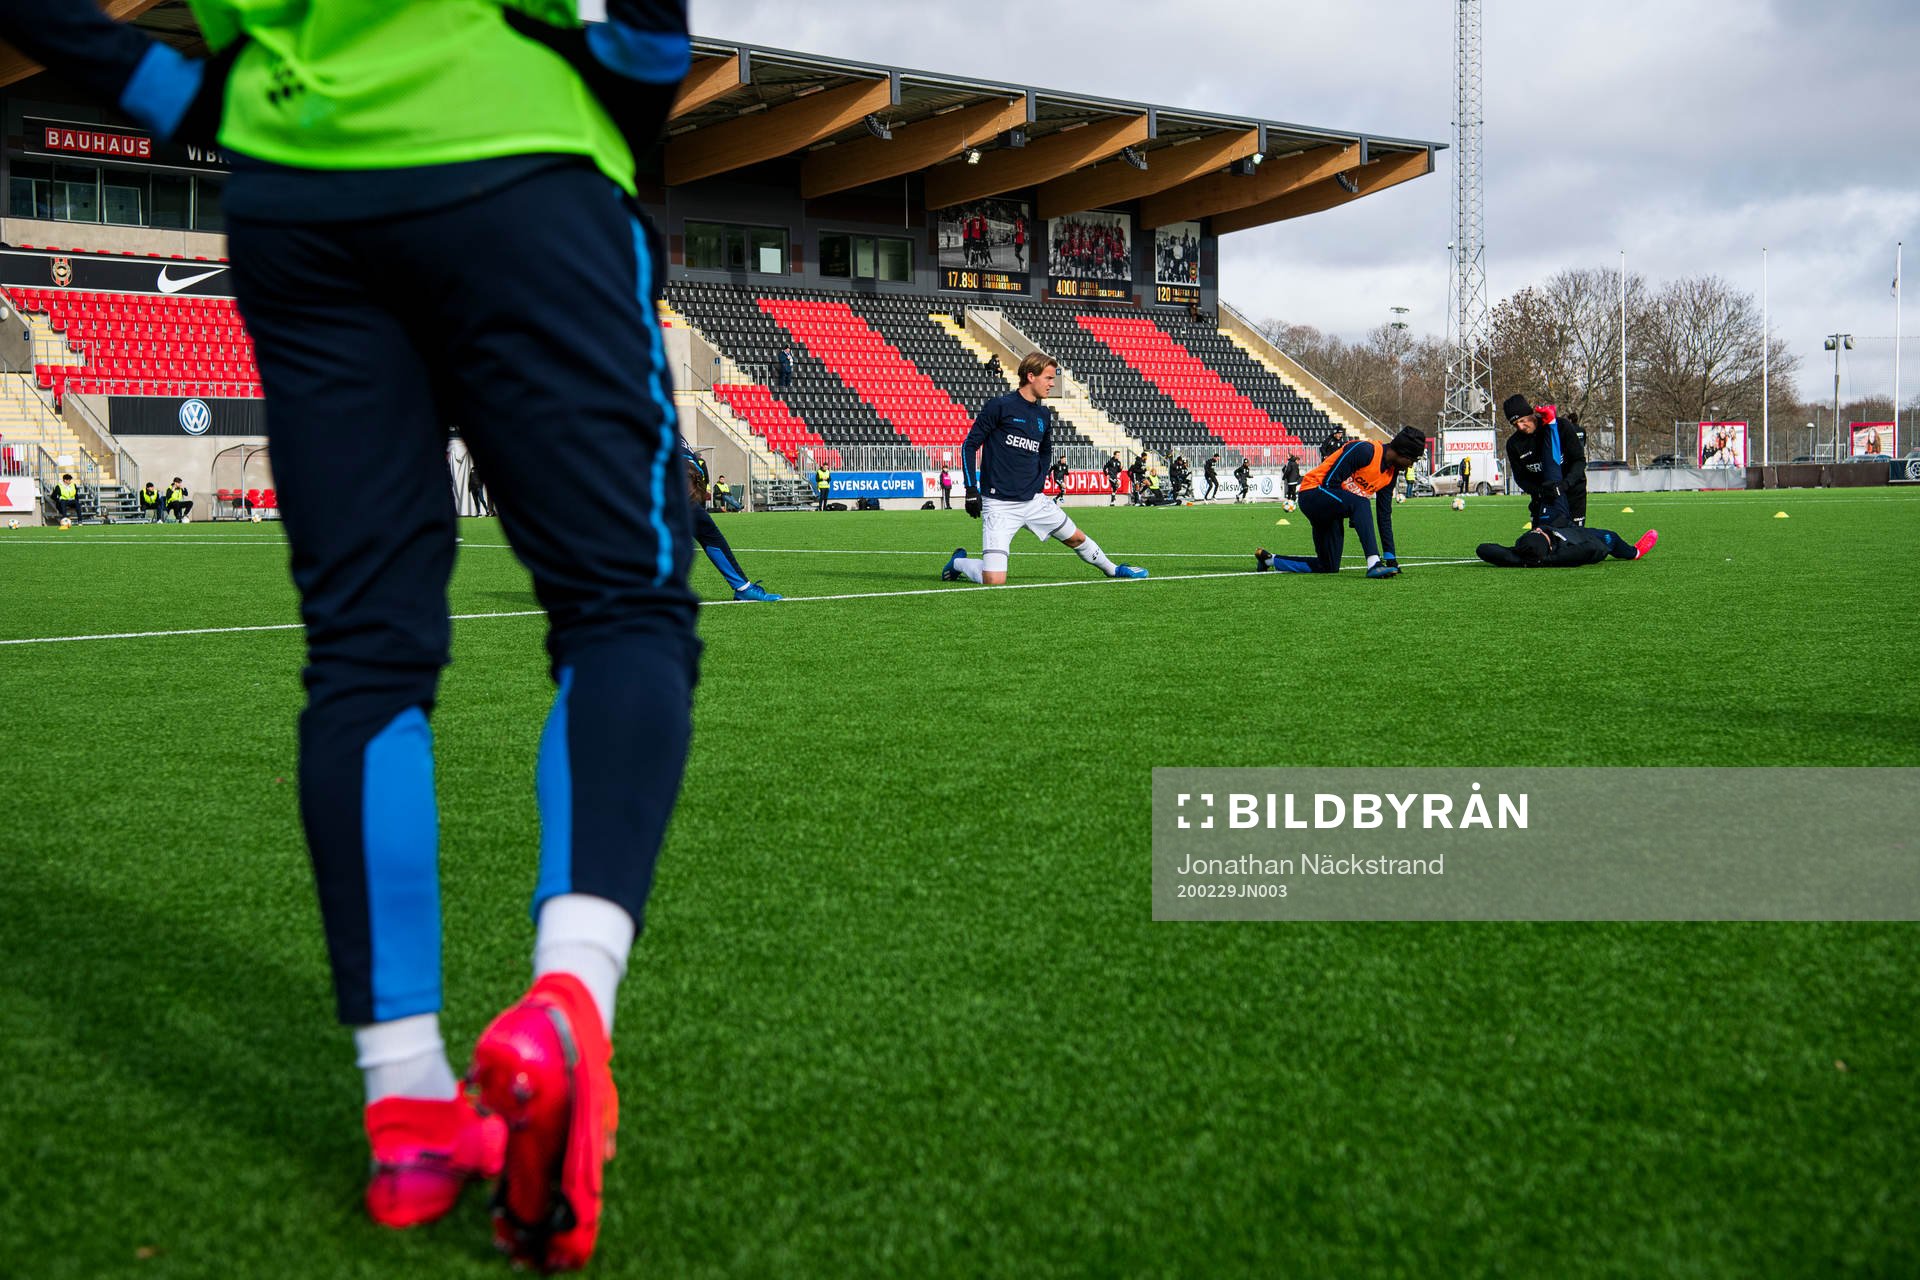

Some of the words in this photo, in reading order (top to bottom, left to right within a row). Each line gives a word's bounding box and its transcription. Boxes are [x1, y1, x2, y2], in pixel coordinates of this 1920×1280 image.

[48, 130, 150, 156] BAUHAUS
[947, 271, 979, 288] 17.890
[1056, 279, 1077, 296] 4000
[1157, 286, 1171, 302] 120
[833, 480, 880, 491] SVENSKA
[882, 479, 915, 491] CUPEN
